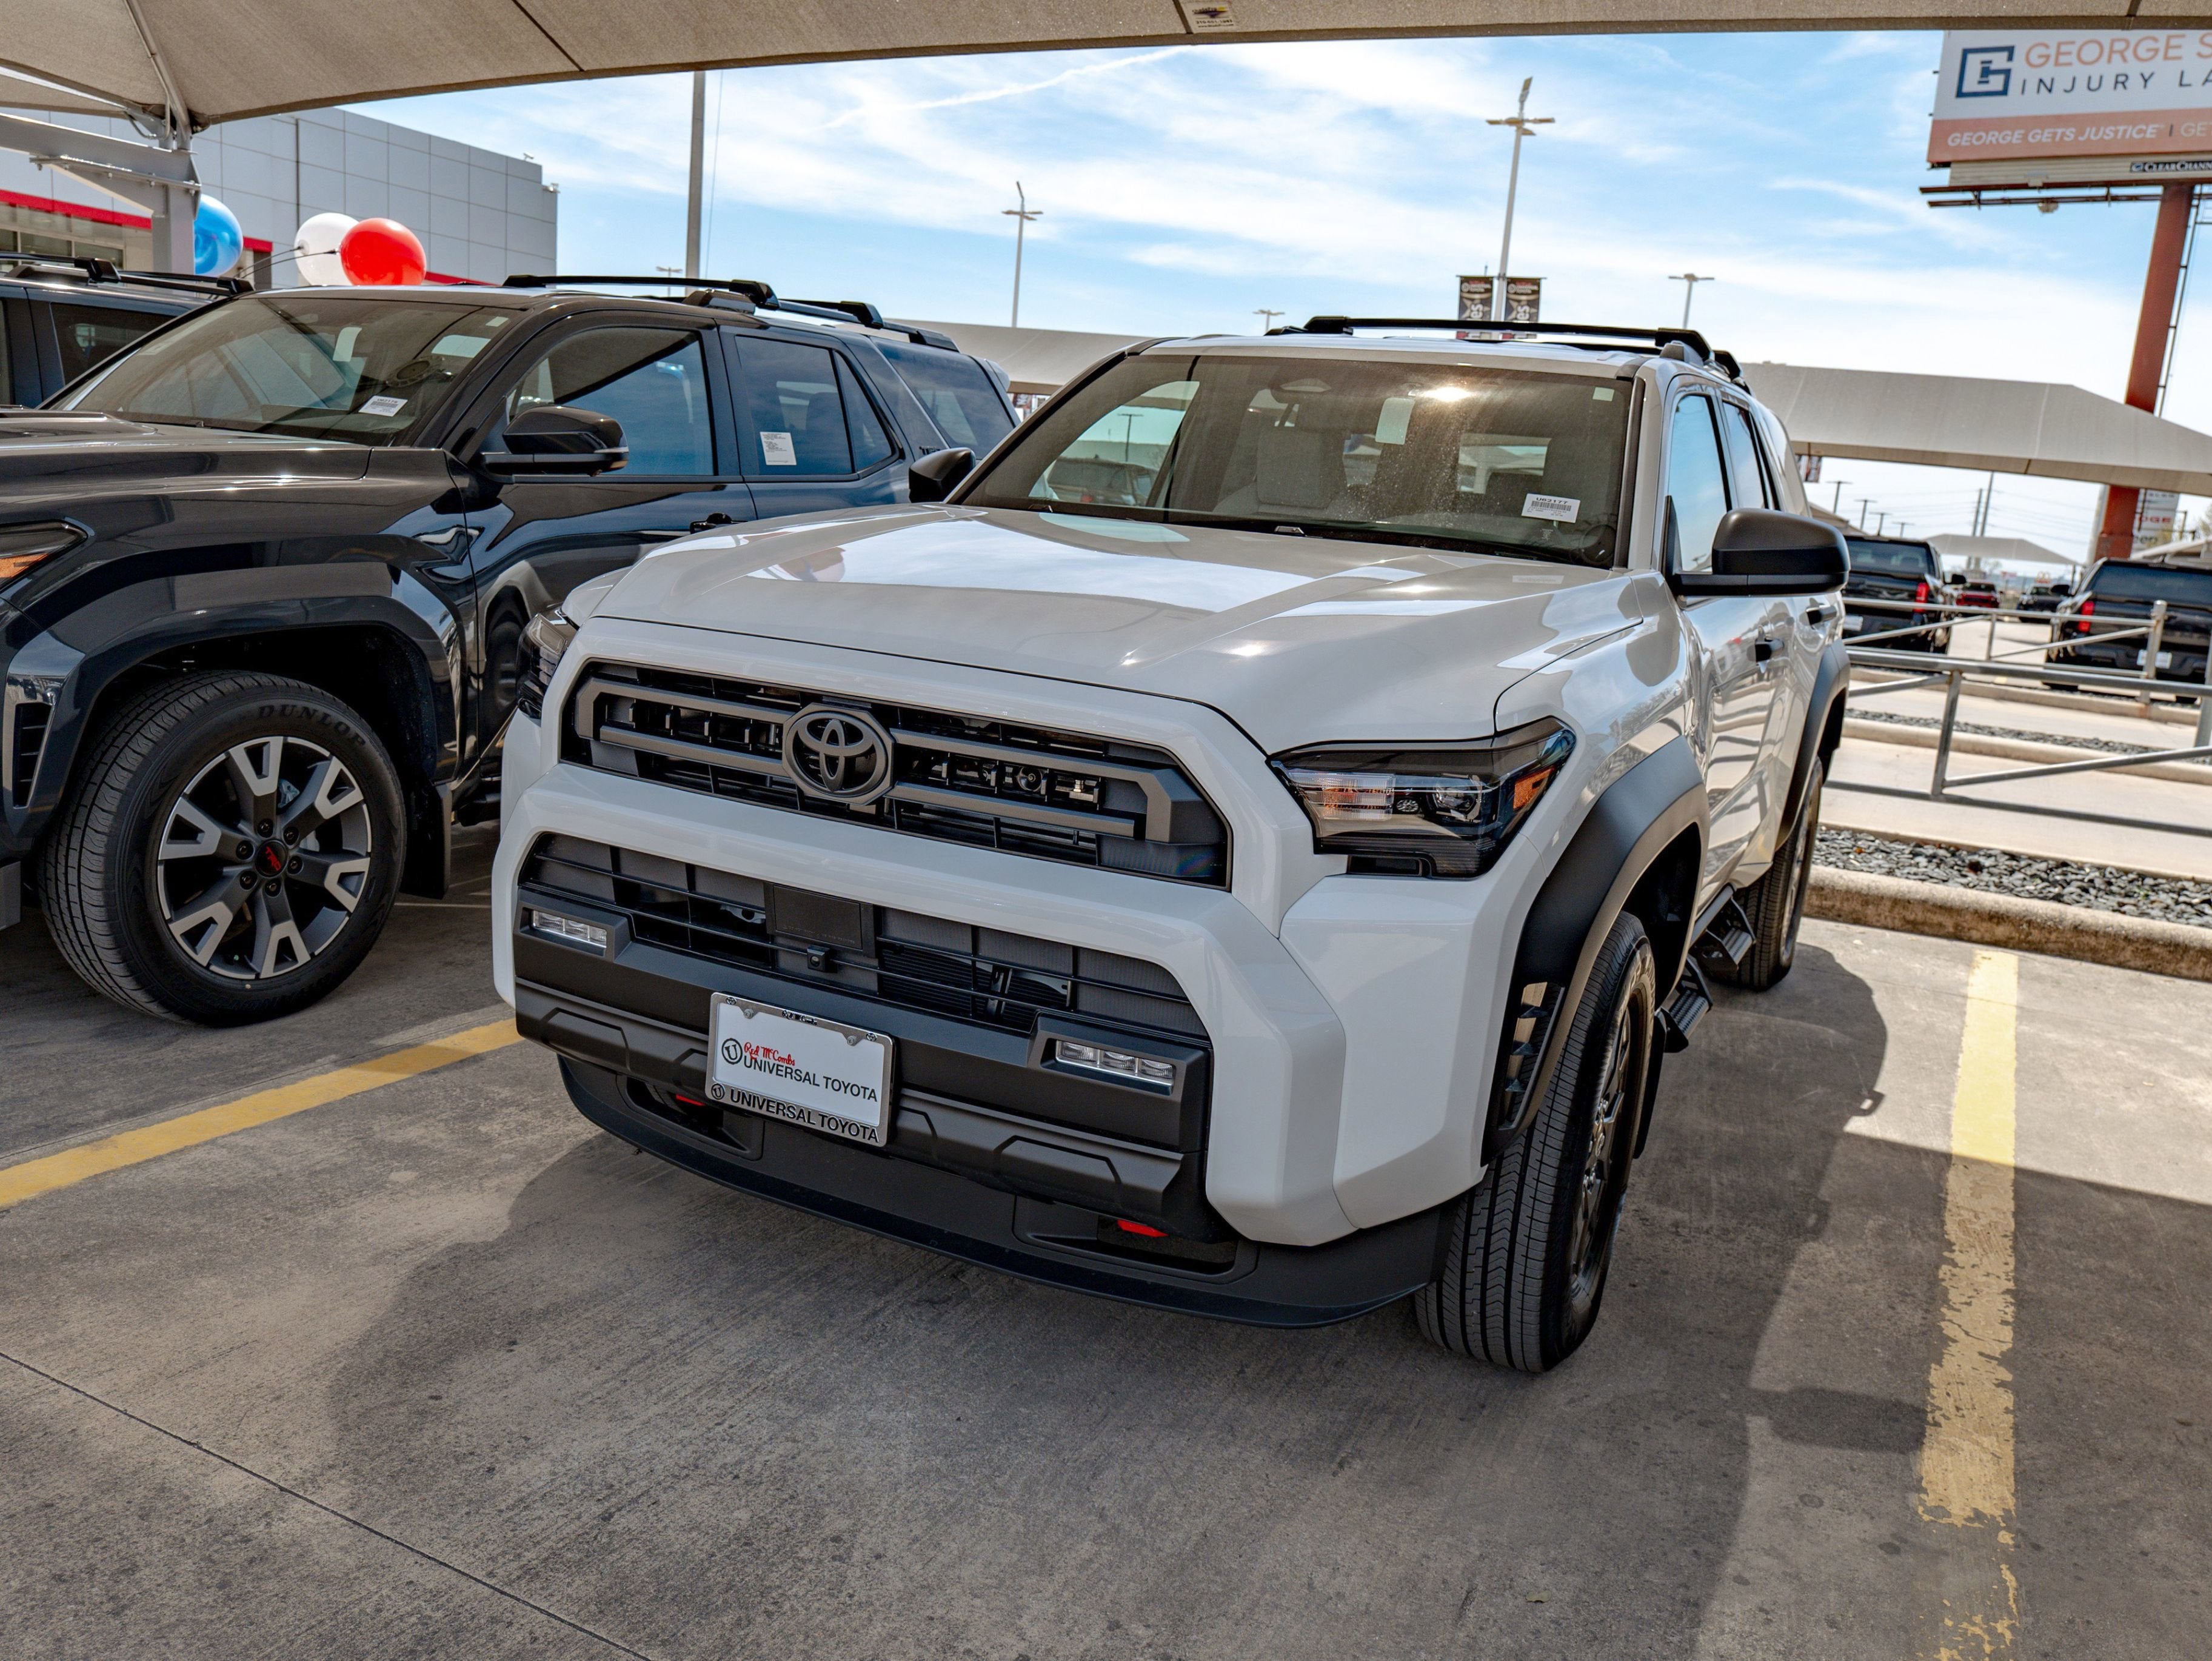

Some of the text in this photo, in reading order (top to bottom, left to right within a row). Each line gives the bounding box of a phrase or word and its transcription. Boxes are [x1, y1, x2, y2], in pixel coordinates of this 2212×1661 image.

[2025, 34, 2186, 69] GEORGE
[2021, 72, 2154, 95] INJURY
[1947, 129, 2025, 147] GEORGE
[2027, 127, 2076, 144] GETS
[2078, 124, 2159, 141] JUSTICE
[258, 704, 366, 745] DUNLOP
[744, 1042, 795, 1066] Red McCombs
[744, 1055, 877, 1102] UNIVERSAL TOYOTA
[730, 1089, 879, 1143] UNIVERSAL TOYOTA
